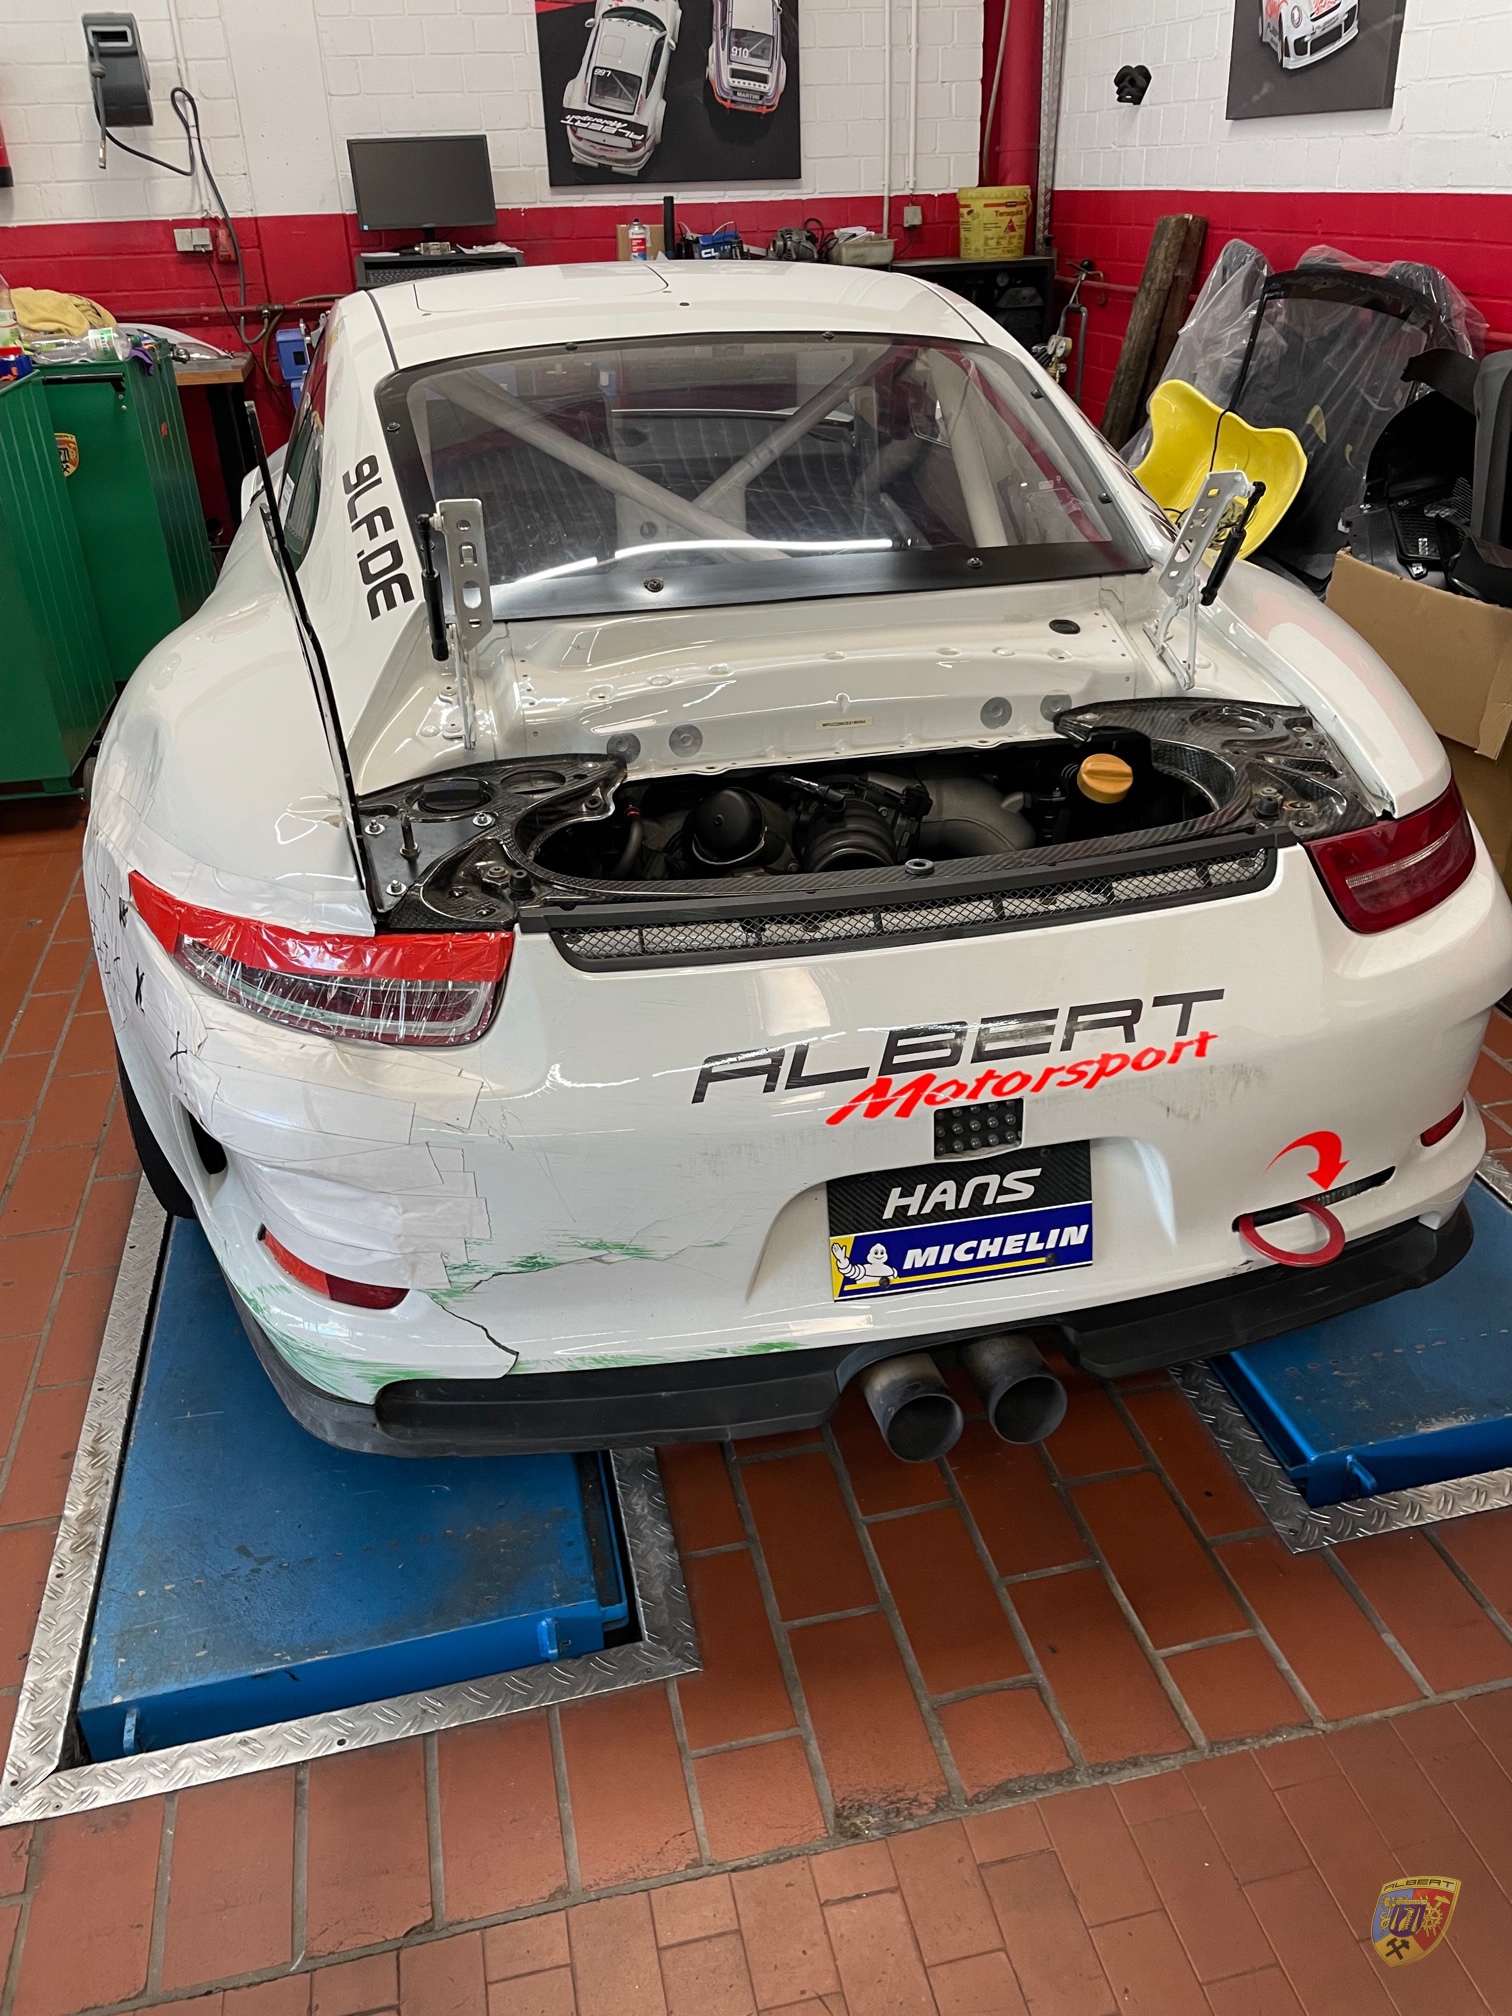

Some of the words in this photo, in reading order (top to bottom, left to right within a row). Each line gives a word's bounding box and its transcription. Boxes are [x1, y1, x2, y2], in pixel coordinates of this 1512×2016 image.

[731, 46, 749, 59] 910
[736, 91, 760, 100] MARTINI
[560, 120, 645, 140] ALBERT
[342, 455, 415, 621] 9LF.DE
[691, 988, 1225, 1104] ALBERT
[825, 1031, 1219, 1126] Motorsport
[882, 1168, 1042, 1220] HANS
[902, 1224, 1089, 1270] MICHELIN
